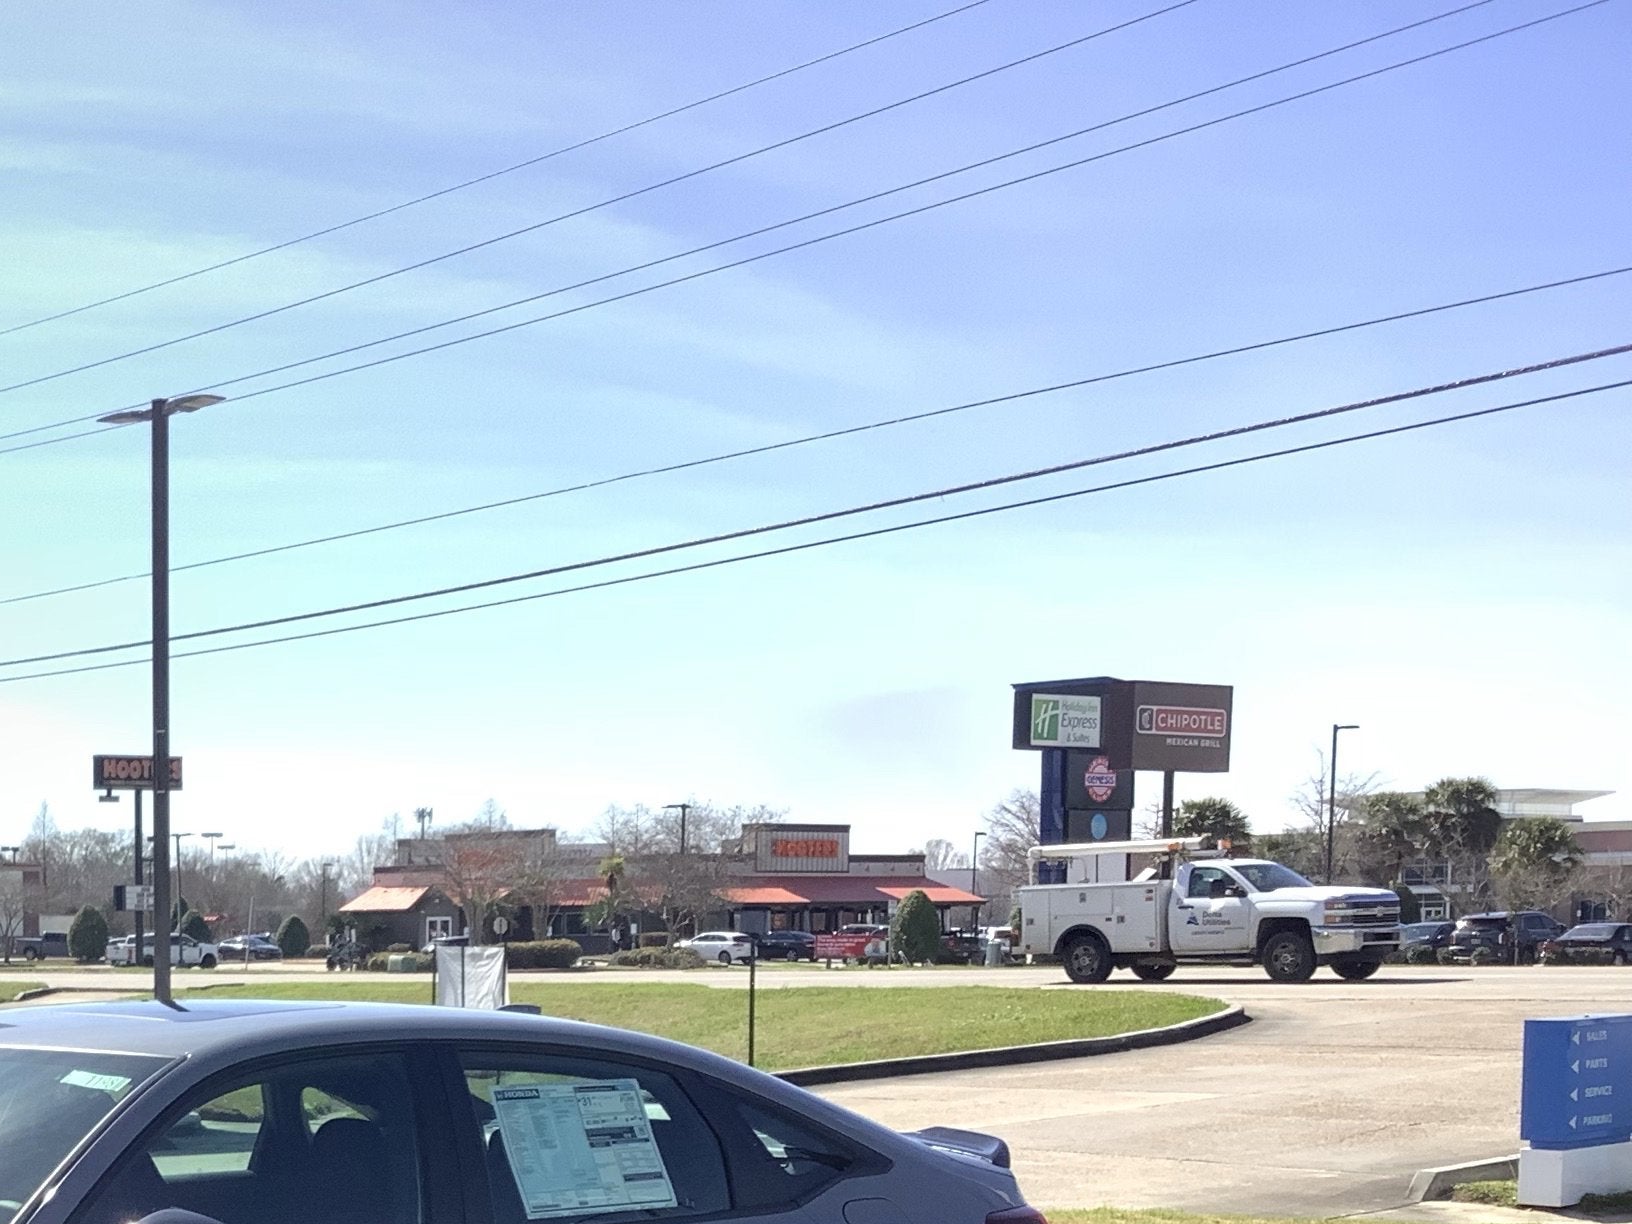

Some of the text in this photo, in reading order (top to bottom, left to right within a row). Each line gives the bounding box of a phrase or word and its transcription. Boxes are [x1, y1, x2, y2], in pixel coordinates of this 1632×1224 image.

[1061, 712, 1097, 731] Express
[1158, 713, 1222, 730] CHIPOTLE
[1072, 733, 1090, 743] Suites
[1166, 738, 1220, 747] MEXICAN GRILL
[103, 759, 182, 780] HOOTS
[1586, 1031, 1607, 1041] SALES
[1585, 1058, 1608, 1069] PARTS
[504, 1089, 539, 1098] HONDA
[1585, 1086, 1612, 1097] SERVICE
[1583, 1114, 1612, 1126] PARKING
